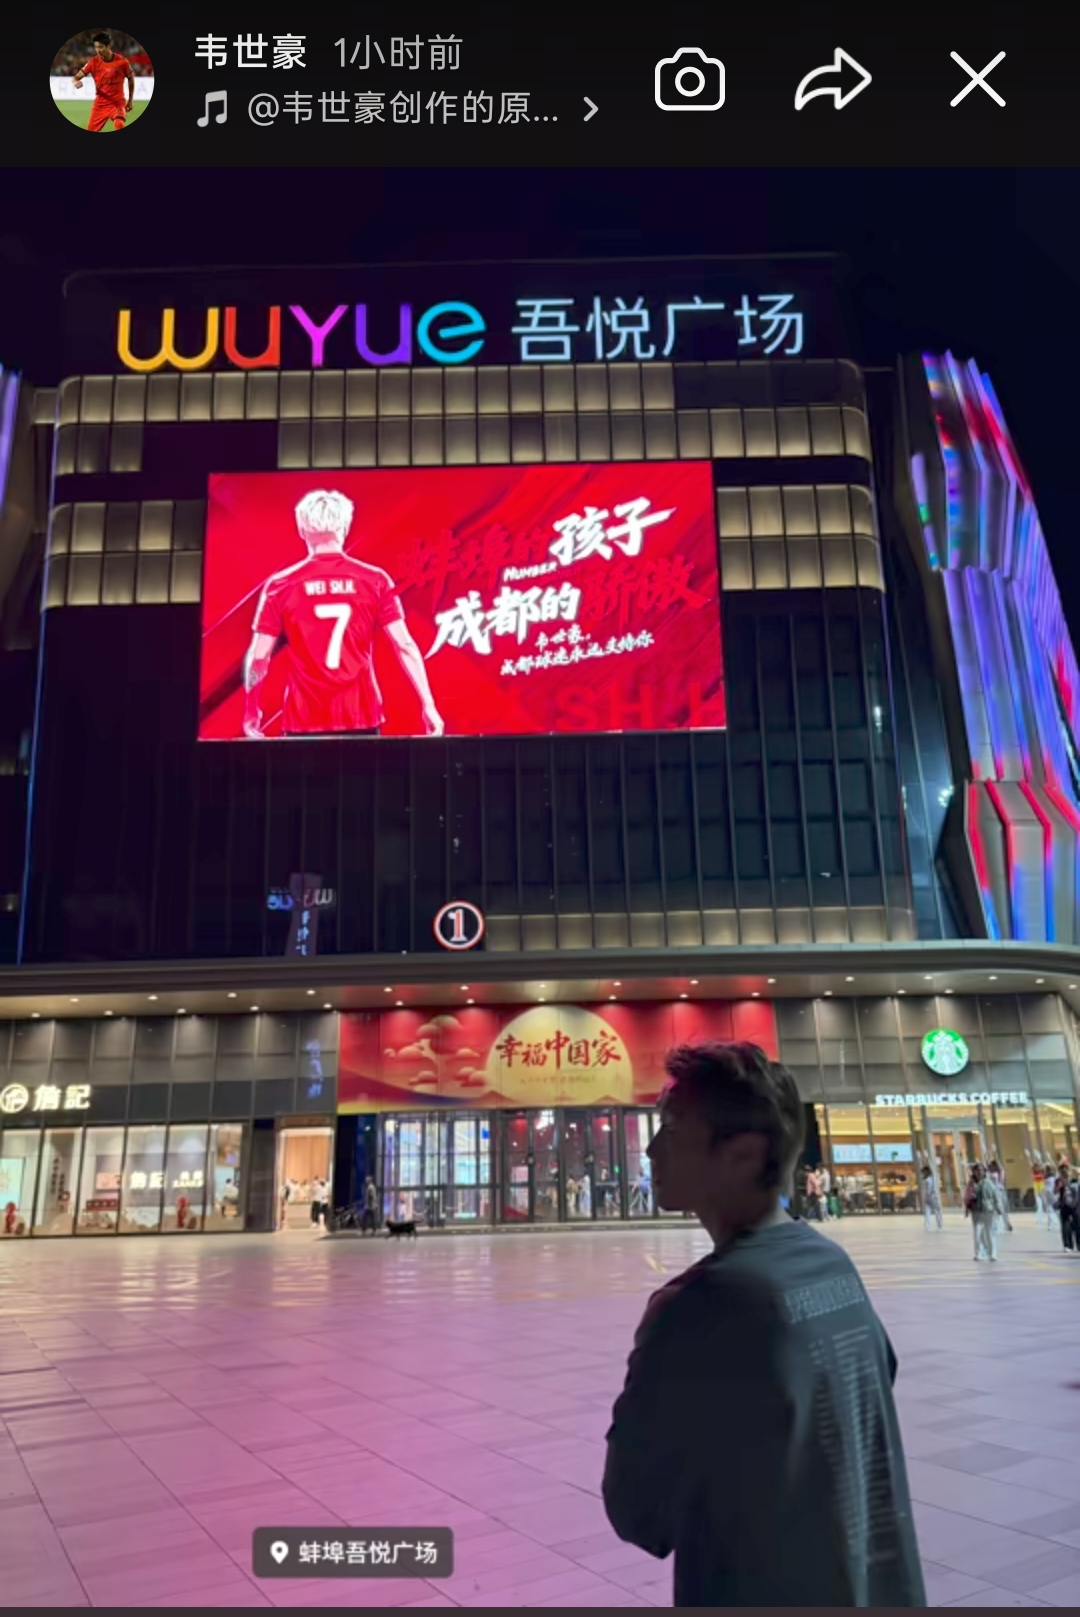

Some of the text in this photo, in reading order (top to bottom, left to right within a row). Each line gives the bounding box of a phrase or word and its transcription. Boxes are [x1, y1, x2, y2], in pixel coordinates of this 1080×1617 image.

[512, 294, 803, 361] 吾悦广场
[303, 579, 327, 596] WEI
[314, 603, 351, 669] 7
[495, 1029, 622, 1070] 幸福中国家
[875, 1091, 1028, 1106] STARBUCKS COFFEE
